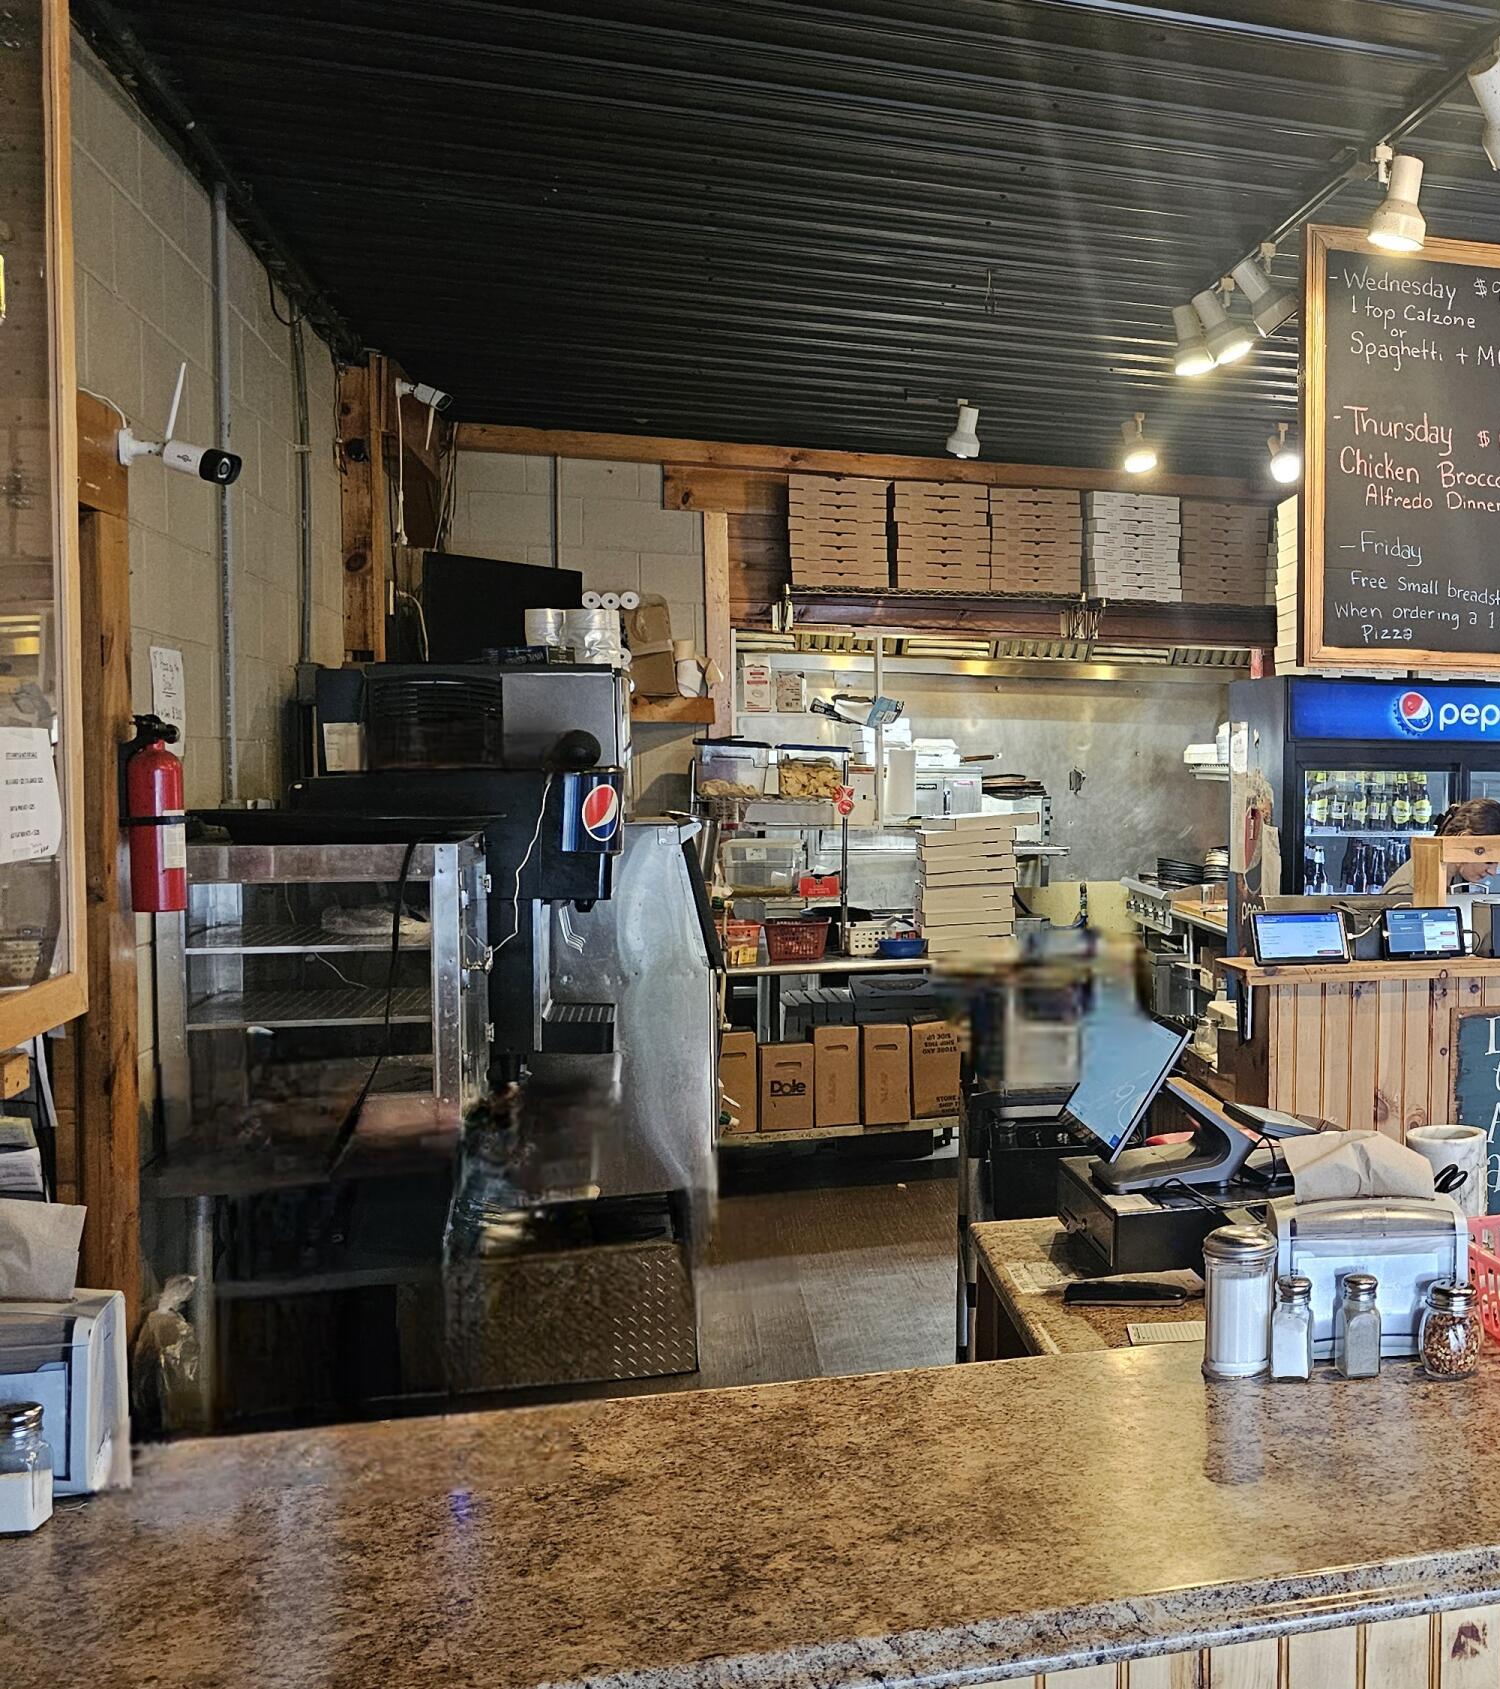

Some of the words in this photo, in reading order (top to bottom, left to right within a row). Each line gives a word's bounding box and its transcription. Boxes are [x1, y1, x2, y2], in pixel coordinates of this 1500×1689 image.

[1344, 266, 1456, 310] Wednesday
[1365, 297, 1396, 329] top
[1404, 305, 1476, 328] Calzone
[1390, 328, 1407, 338] or
[1350, 331, 1443, 372] Spaghetti
[1344, 405, 1453, 457] Thursday
[1339, 446, 1420, 484] Chicken
[1365, 483, 1433, 510] Alfredo
[1359, 531, 1423, 568] Friday
[1350, 570, 1388, 590] Free
[1397, 576, 1439, 595] Small
[1334, 601, 1383, 619] When
[1392, 605, 1460, 630] ordering
[1468, 612, 1478, 626] a
[1488, 611, 1495, 629] 1
[1361, 624, 1413, 644] Pizza
[770, 1079, 806, 1096] Dole
